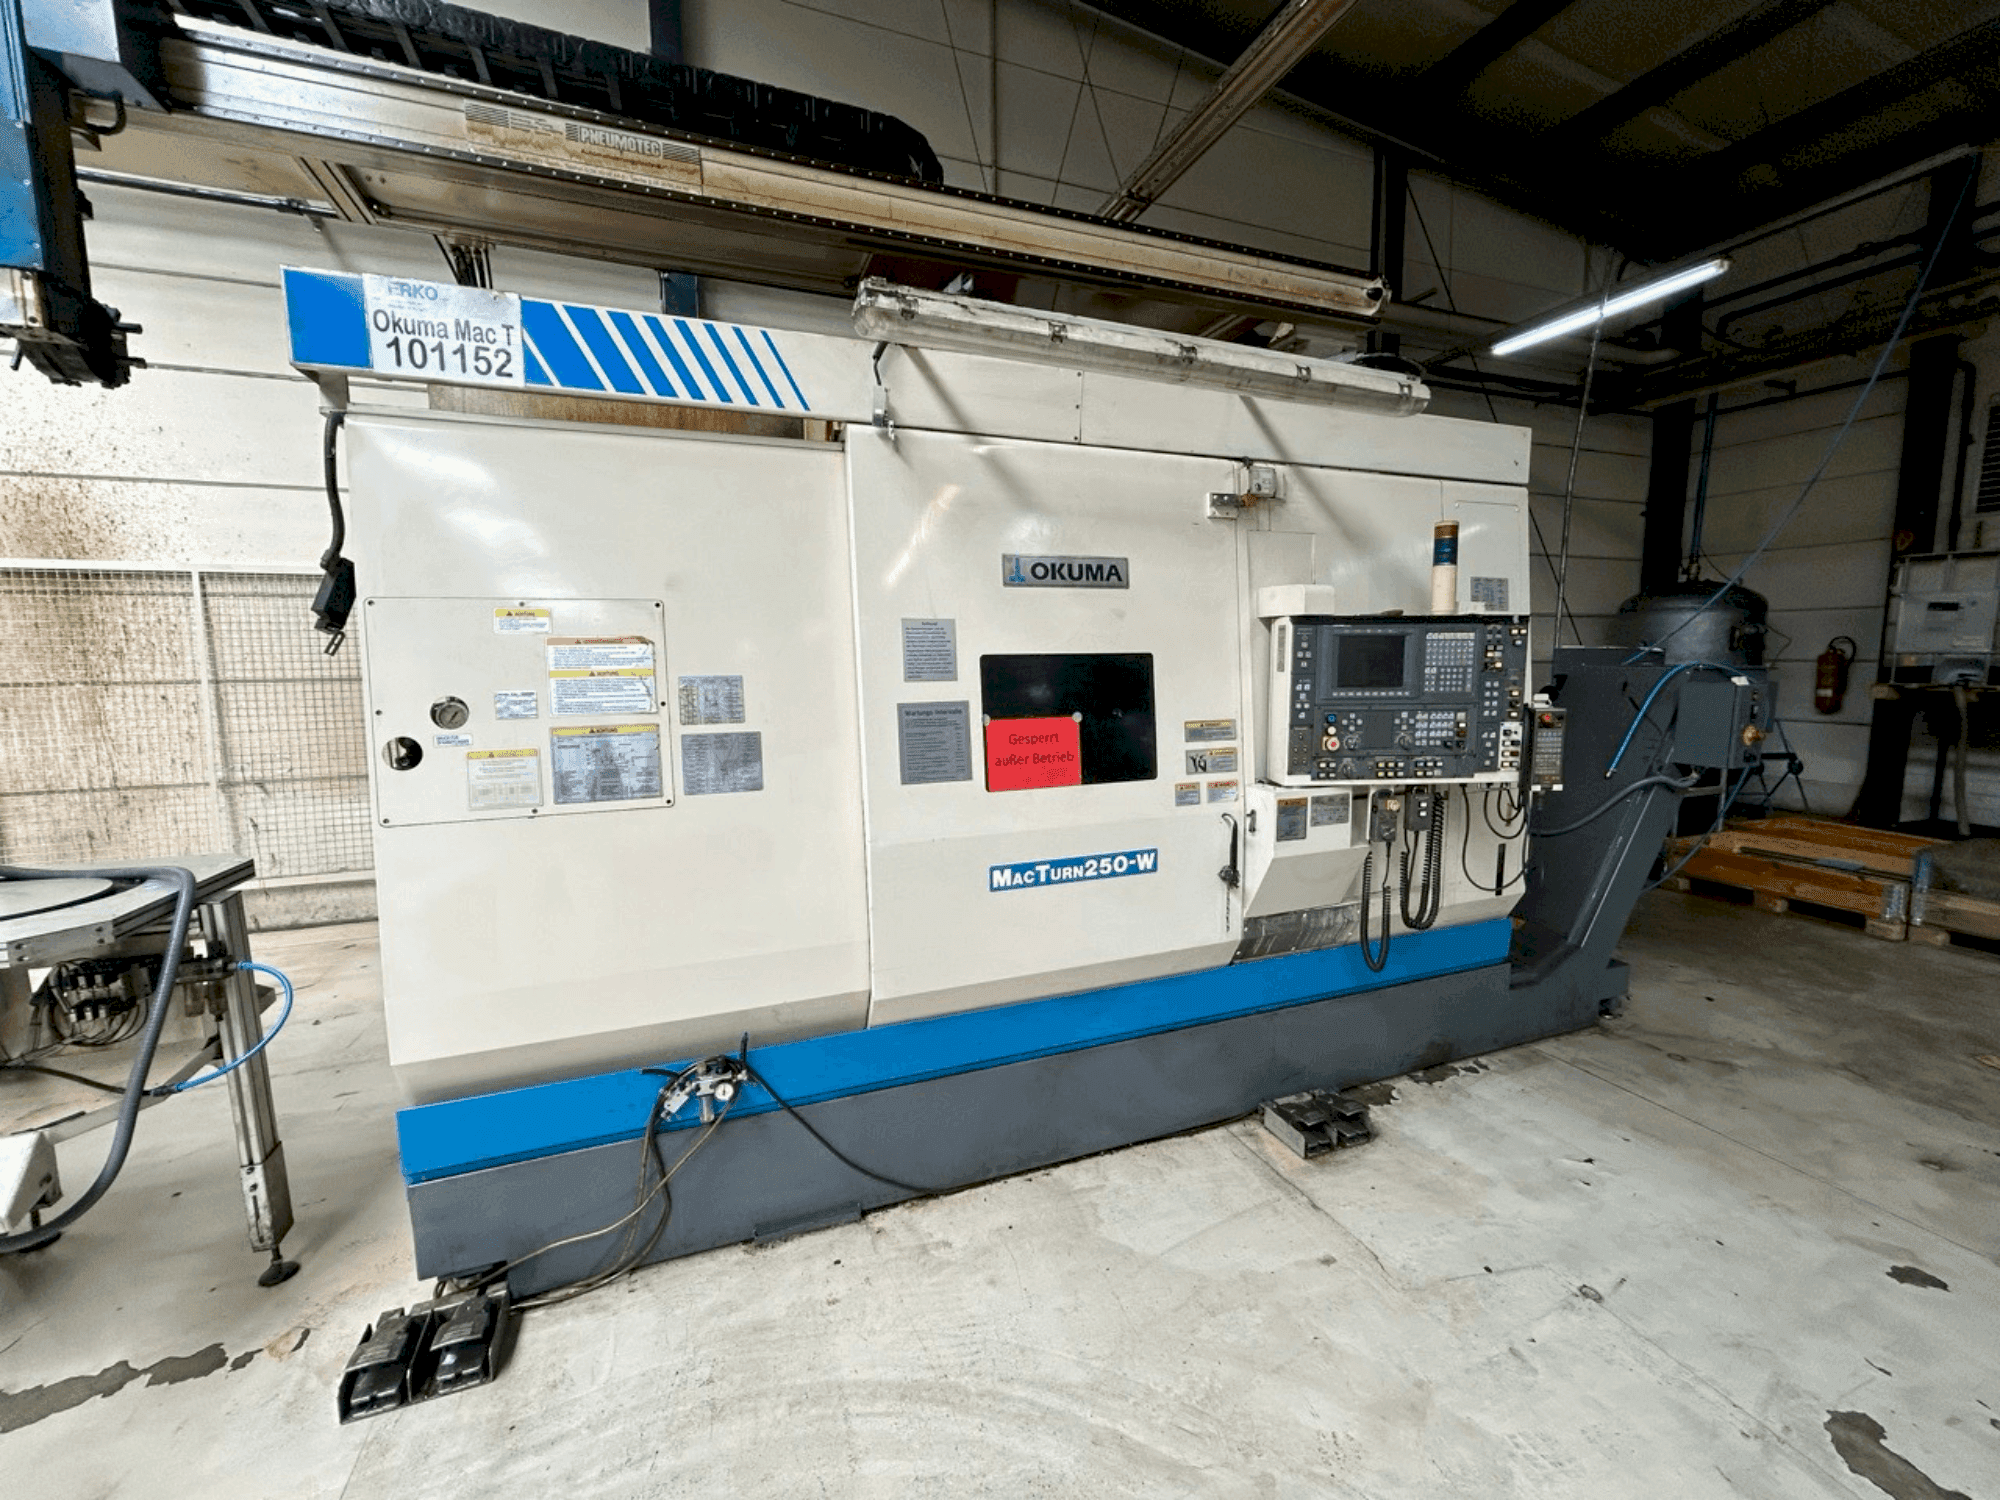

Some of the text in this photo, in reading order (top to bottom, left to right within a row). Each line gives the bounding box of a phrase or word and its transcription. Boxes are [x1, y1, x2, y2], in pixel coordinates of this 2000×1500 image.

[580, 127, 662, 157] PNEUMOTEC
[372, 308, 515, 346] Okuma Mac T
[386, 335, 513, 378] 101152
[1030, 562, 1123, 582] OKUMA
[994, 753, 1030, 767] außer
